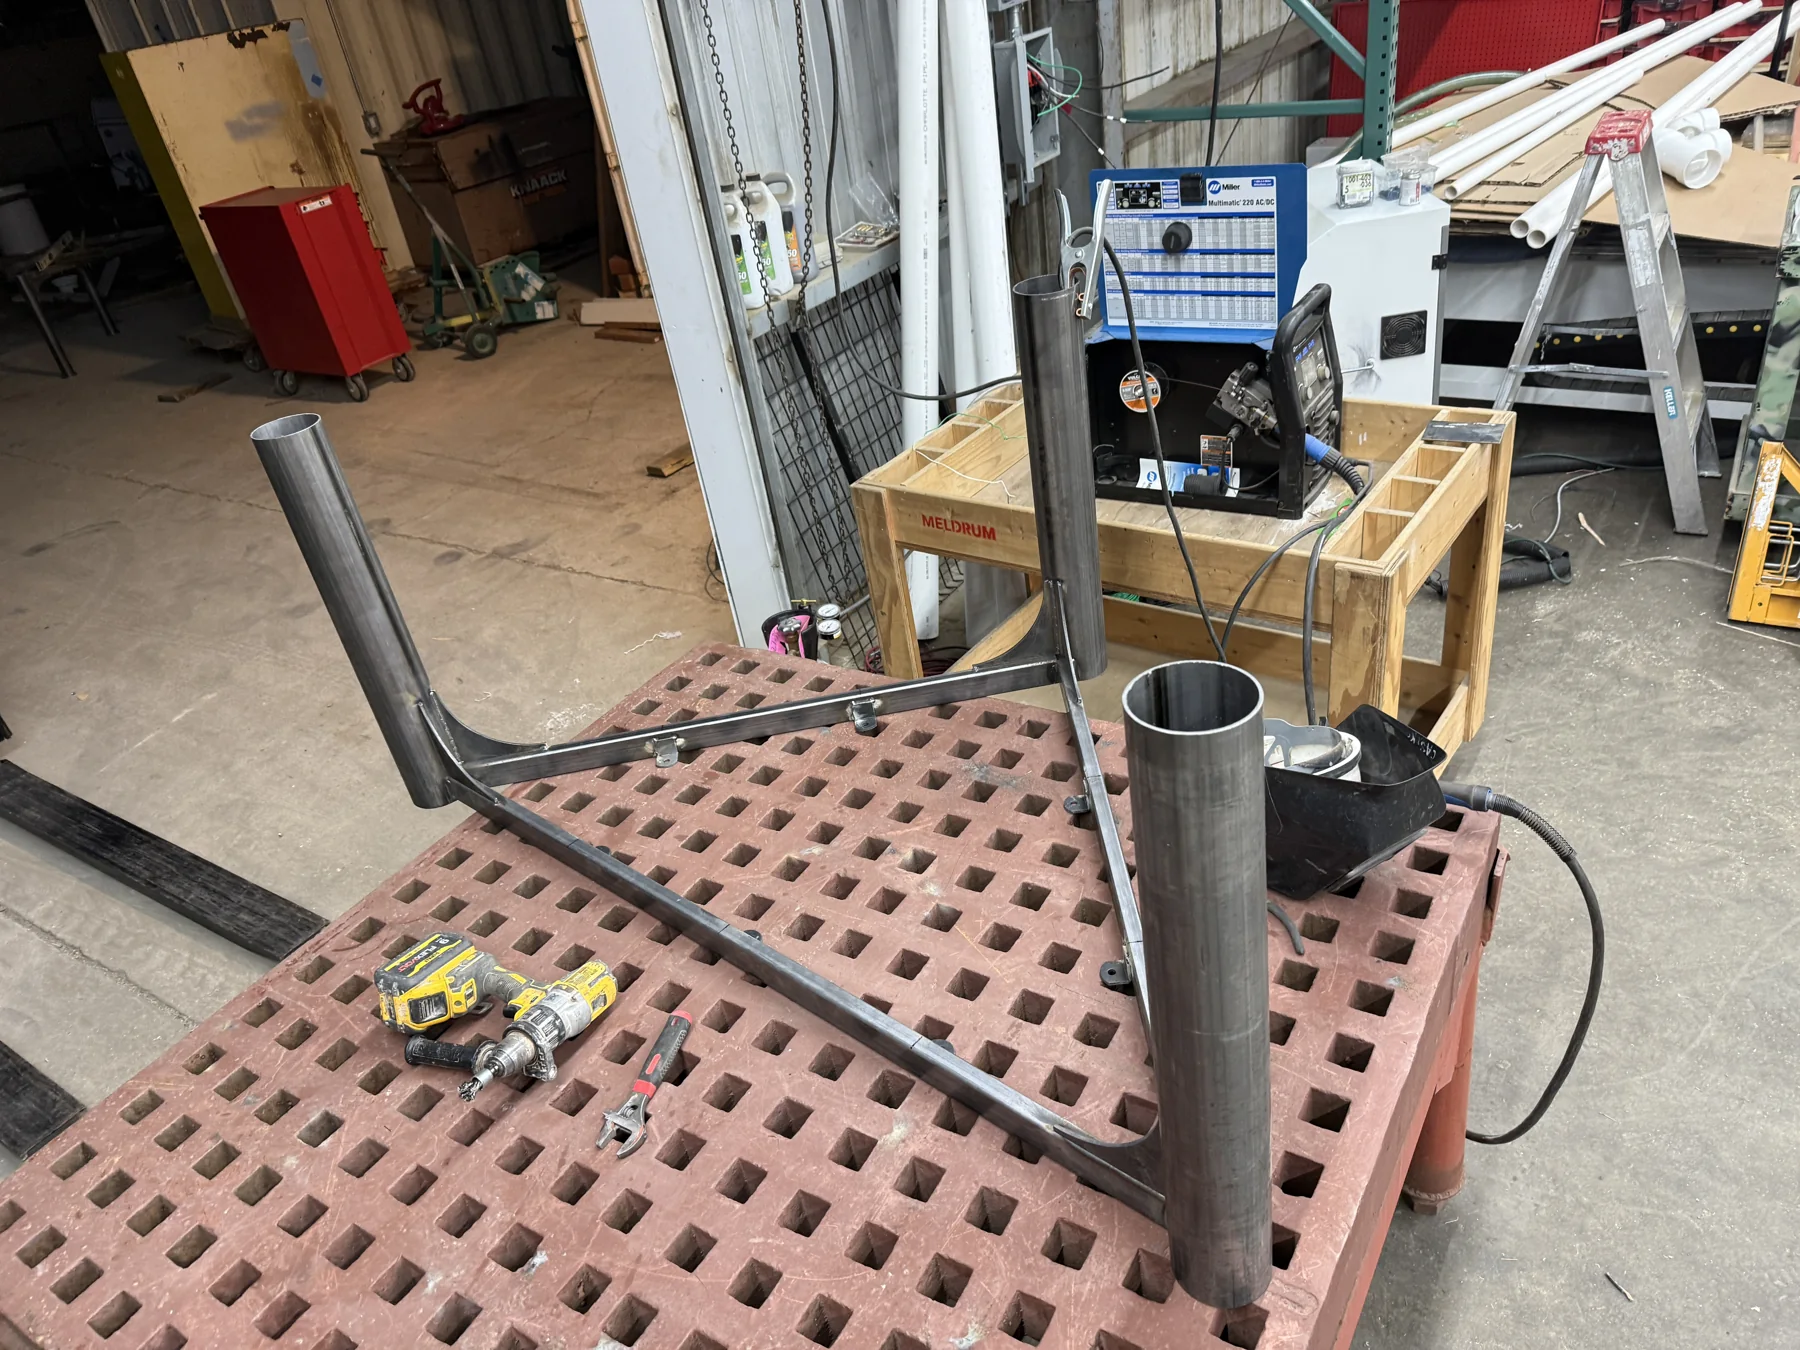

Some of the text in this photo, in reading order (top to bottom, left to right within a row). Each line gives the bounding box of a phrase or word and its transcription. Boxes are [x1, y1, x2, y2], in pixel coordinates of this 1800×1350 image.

[510, 169, 567, 197] KNAACK
[1663, 388, 1676, 416] KELLER
[921, 513, 997, 541] MELDRUM
[398, 945, 437, 973] FLEXVOLT
